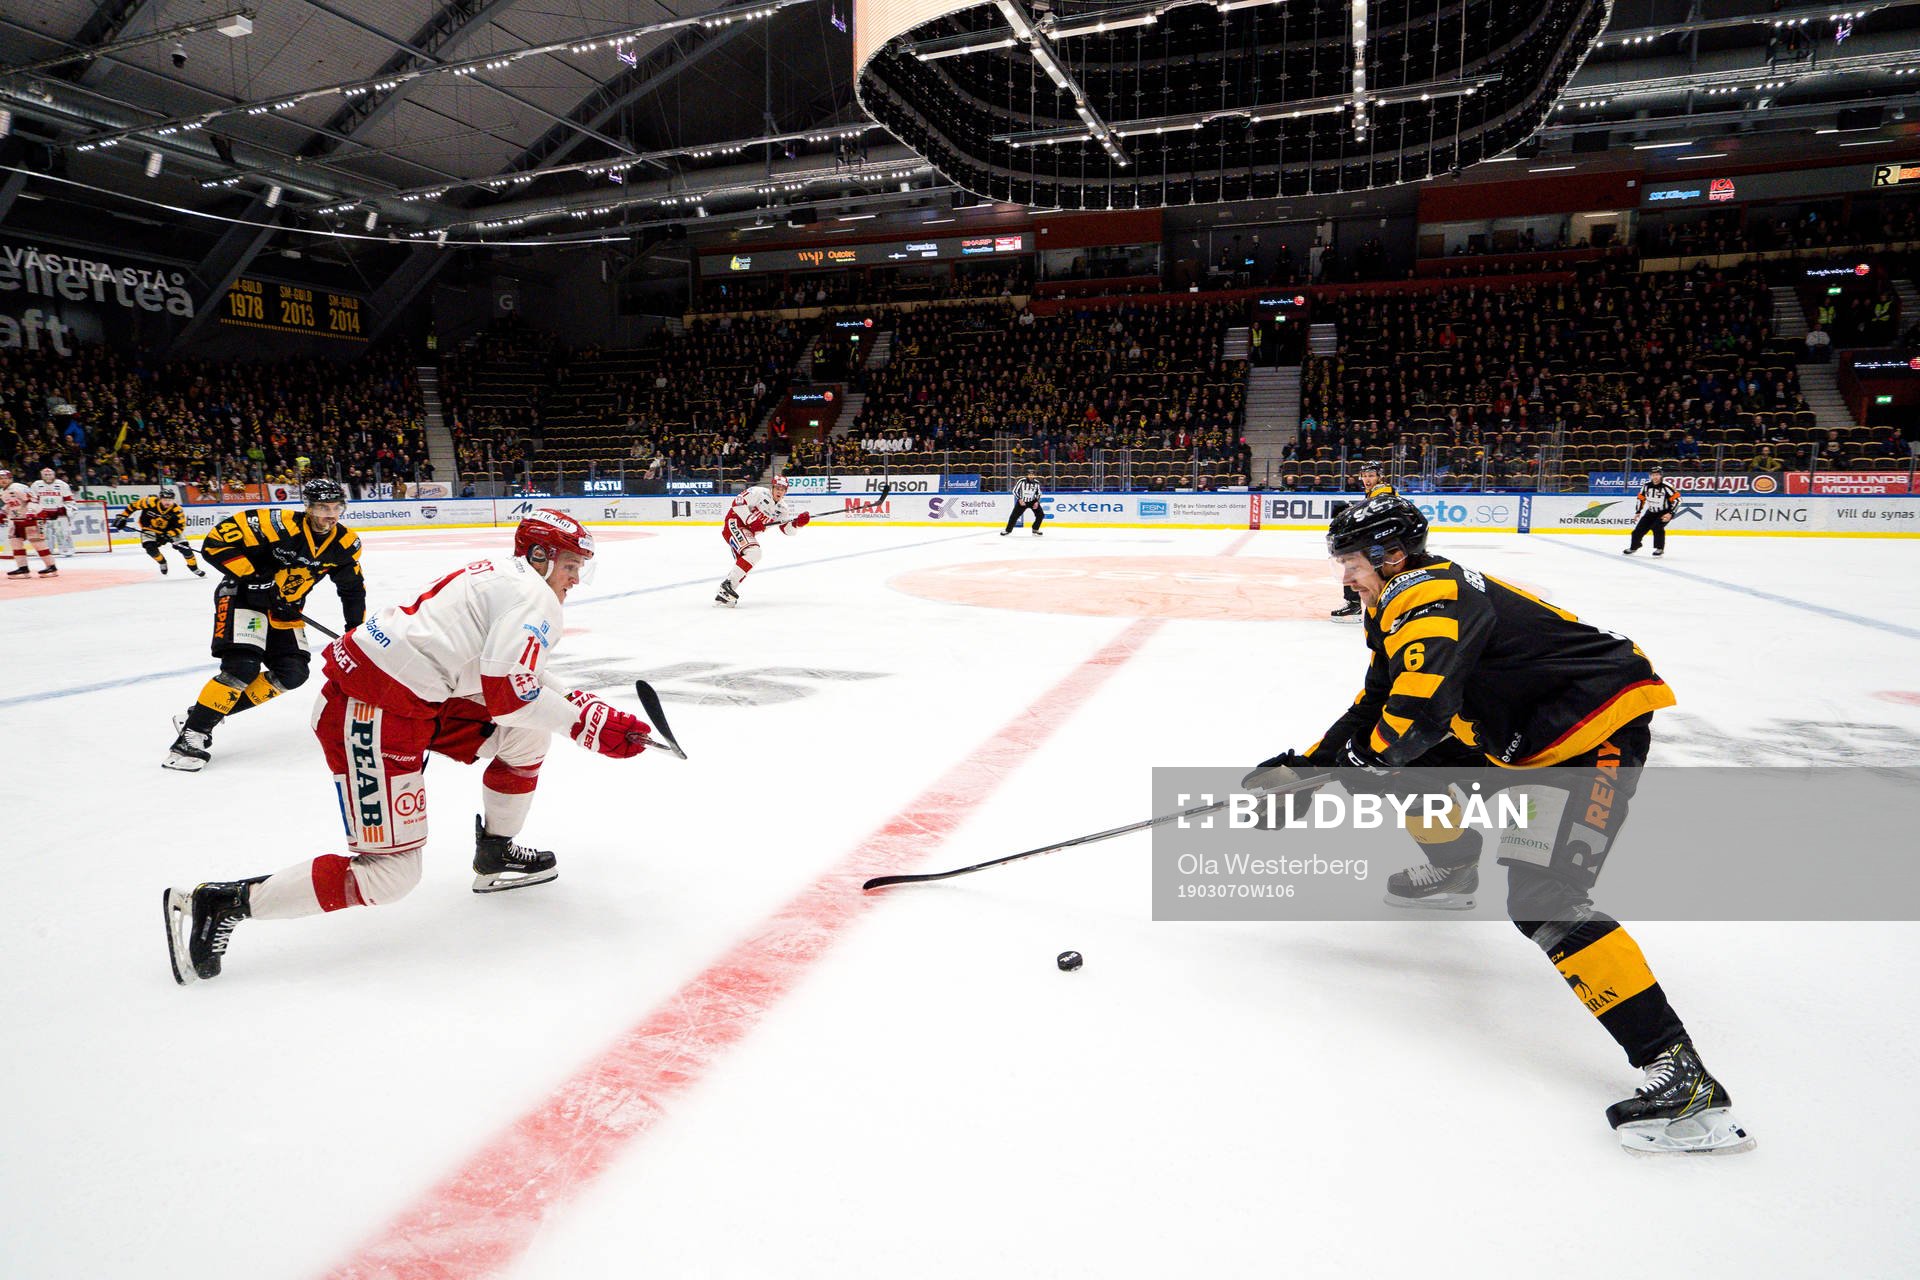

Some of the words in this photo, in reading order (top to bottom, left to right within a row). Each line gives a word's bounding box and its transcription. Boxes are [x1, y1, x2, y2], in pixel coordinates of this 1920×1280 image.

[1711, 179, 1735, 191] ICA
[3, 245, 116, 283] VÄSTRA
[121, 267, 170, 292] STÅ
[229, 292, 264, 320] 1978
[499, 294, 514, 311] G
[280, 300, 315, 327] 2013
[329, 308, 360, 333] 2014
[584, 481, 622, 491] BASTU
[787, 478, 825, 487] SPORT
[866, 479, 928, 492] Henson
[1663, 477, 1693, 490] BIG
[1800, 475, 1908, 484] NORDLUNDS
[1822, 485, 1886, 494] MOTOR
[845, 498, 890, 514] MAXI
[960, 500, 996, 508] Skellefteå
[1056, 501, 1124, 513] extena
[185, 511, 215, 527] bilen!
[337, 507, 411, 522] ndelsbanken
[604, 508, 618, 519] EY
[1715, 508, 1808, 522] KAIDING
[1837, 508, 1857, 519] Vill
[1862, 508, 1877, 519] du
[1881, 510, 1914, 521] synas
[1559, 517, 1636, 525] NORRMASKINER
[219, 523, 243, 544] 40
[519, 635, 541, 671] 11
[1403, 642, 1425, 672] 6
[583, 704, 607, 750] BAUER
[351, 719, 383, 827] PEAB
[1551, 951, 1564, 962] CM
